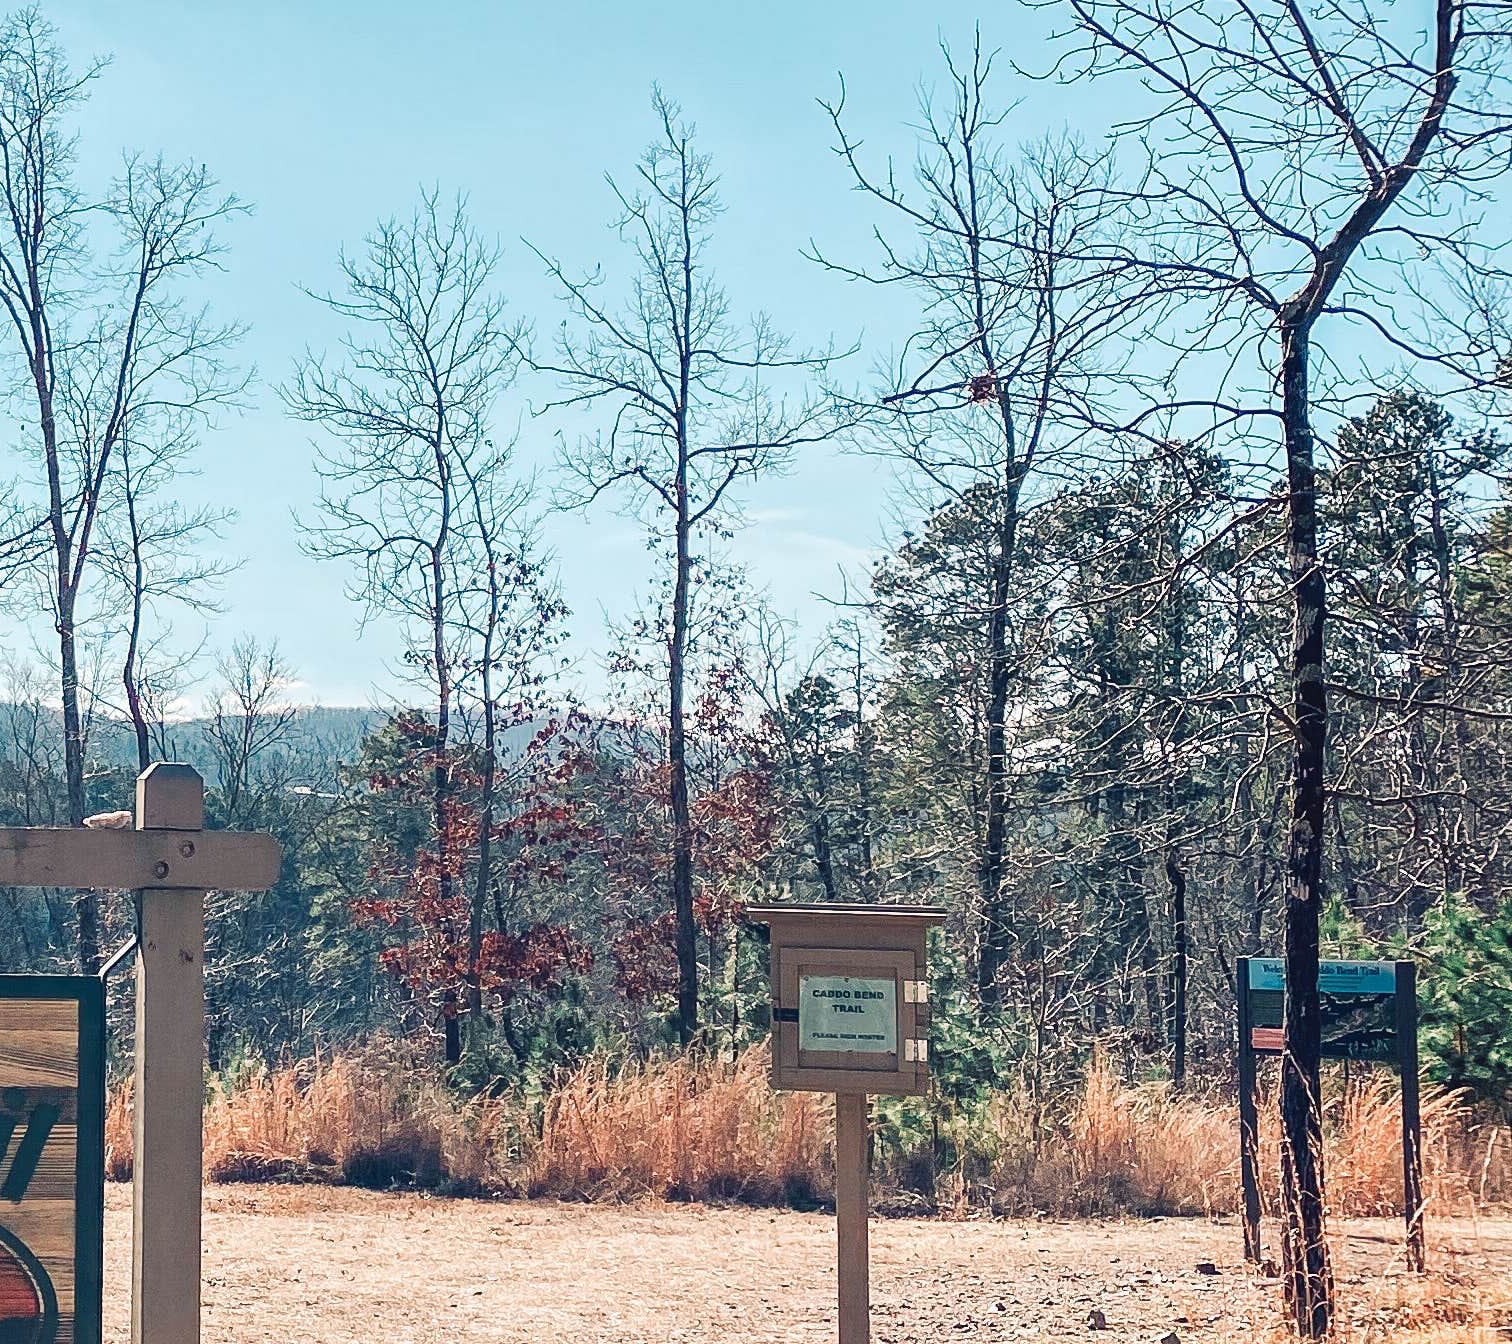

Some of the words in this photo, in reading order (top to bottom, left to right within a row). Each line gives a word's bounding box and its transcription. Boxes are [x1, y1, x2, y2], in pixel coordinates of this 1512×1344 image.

[812, 989, 851, 999] CADDO
[854, 990, 885, 1000] BEND
[832, 1004, 865, 1014] TRAIL
